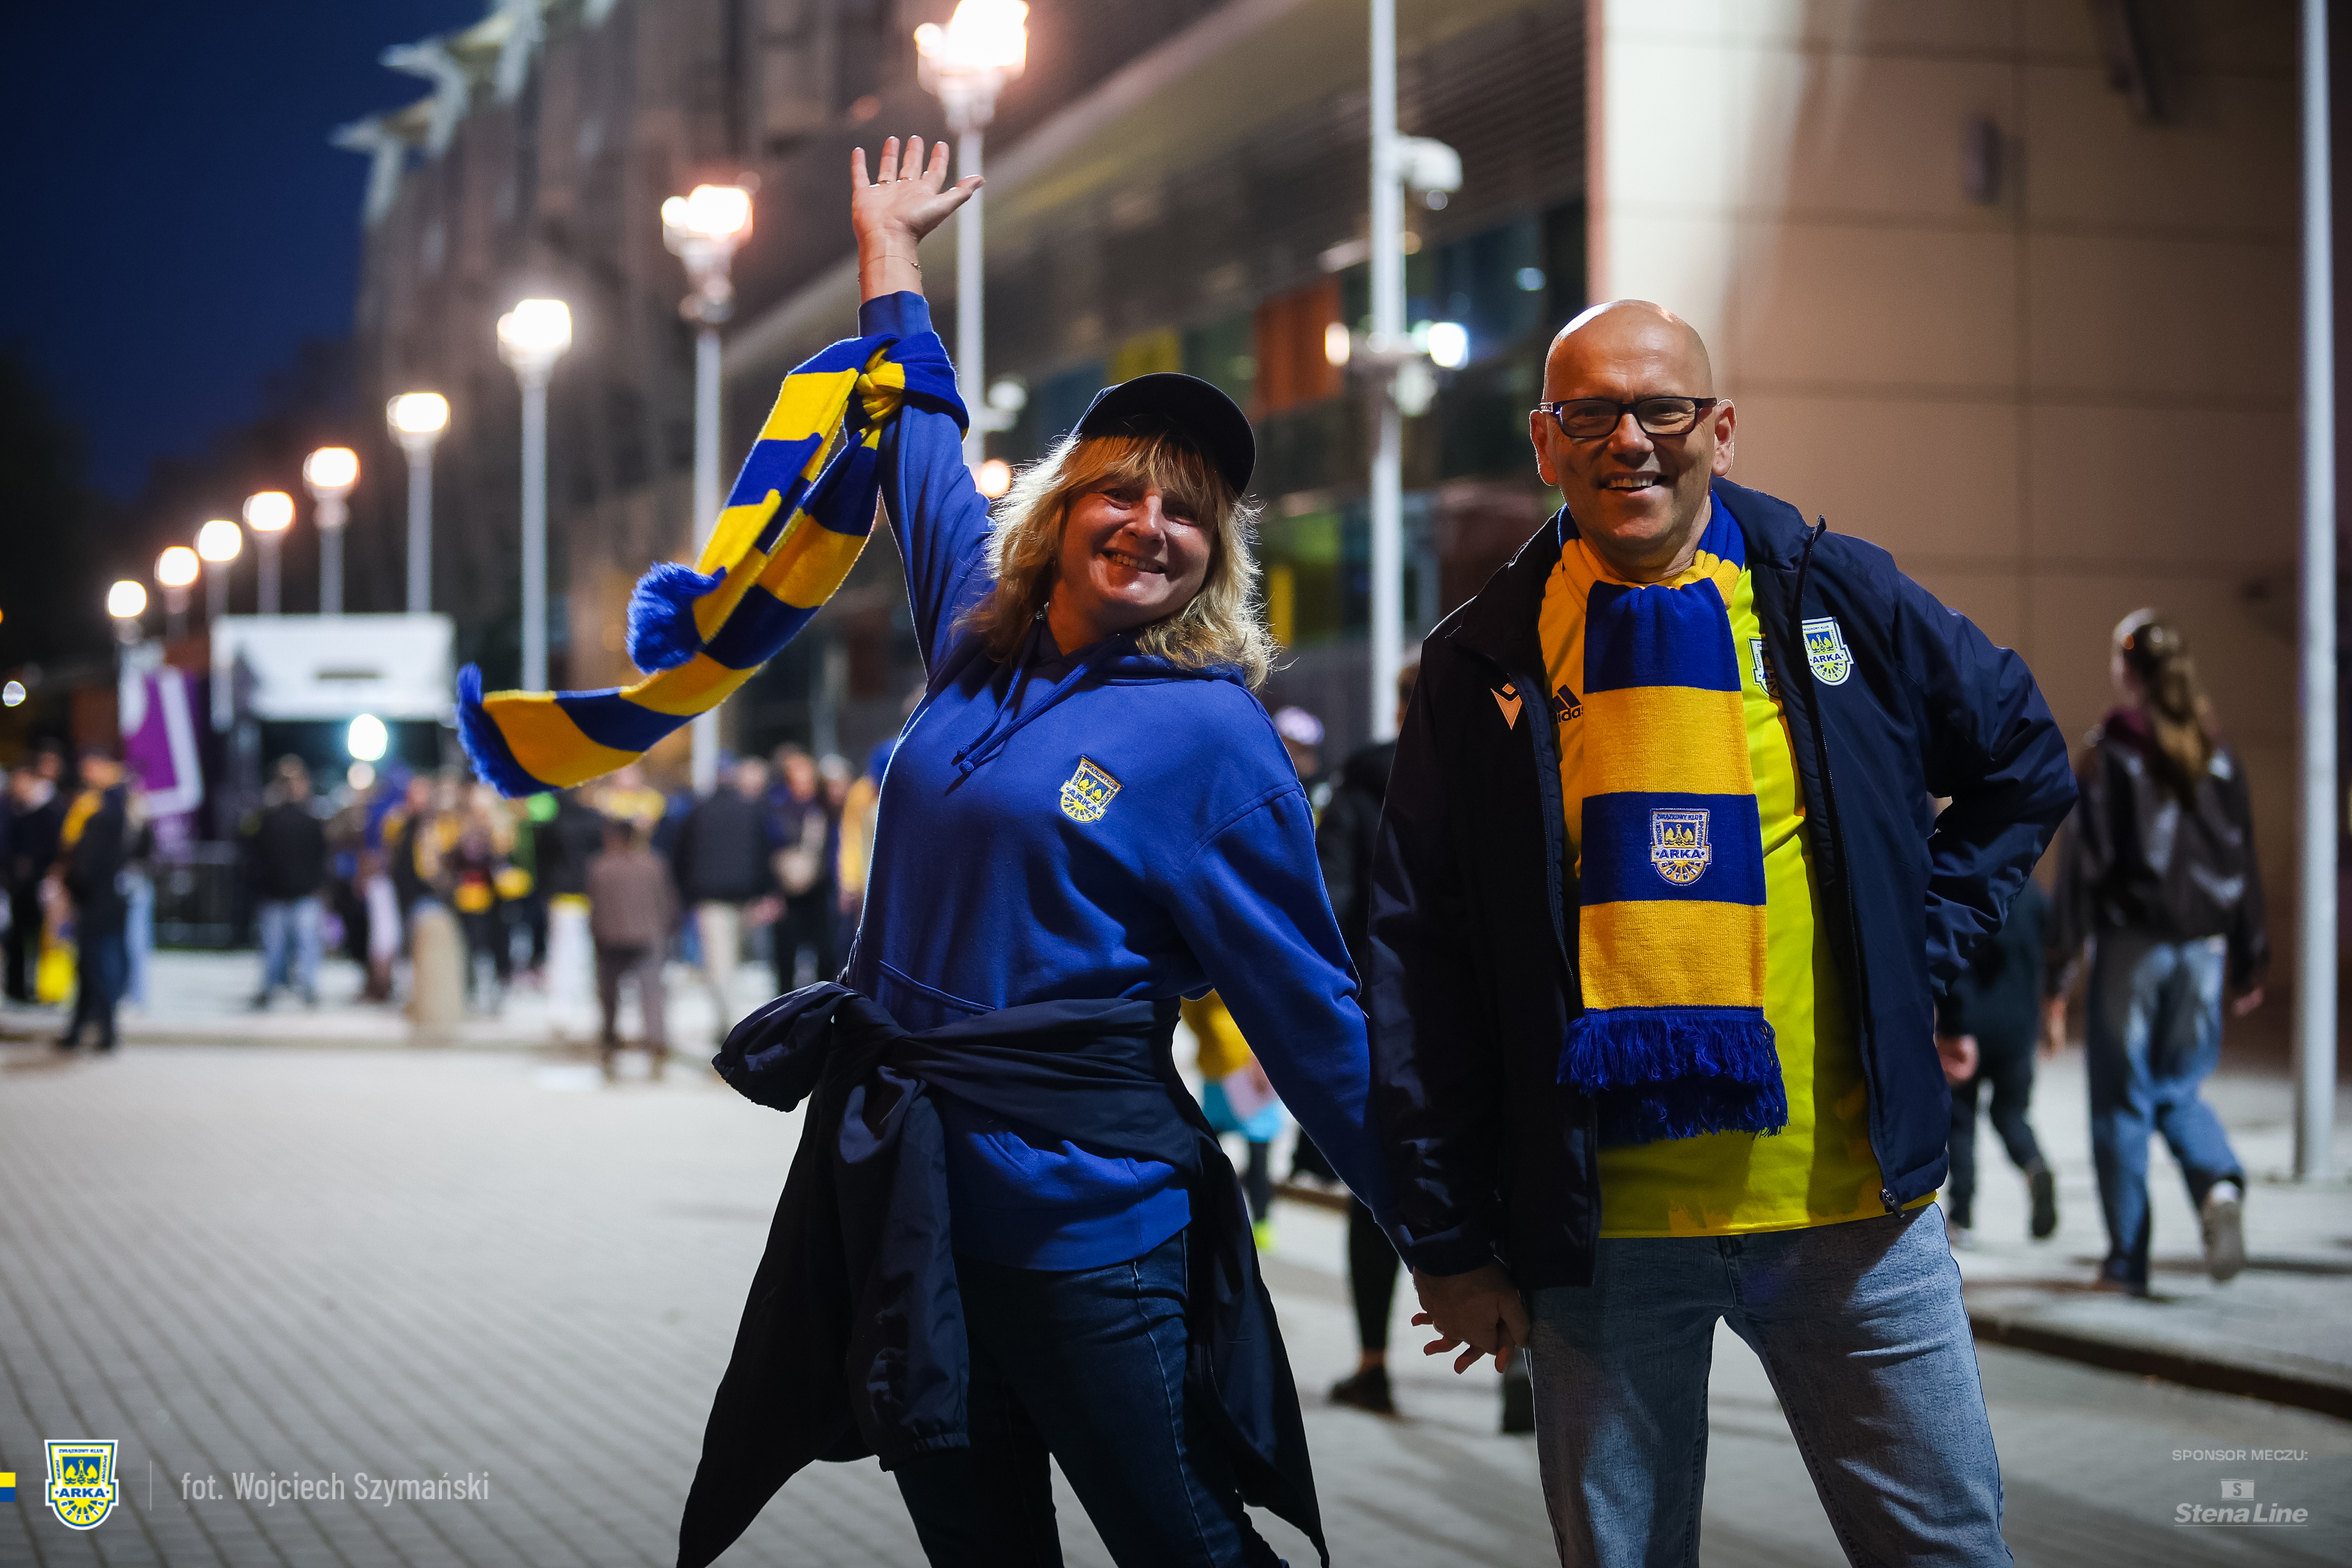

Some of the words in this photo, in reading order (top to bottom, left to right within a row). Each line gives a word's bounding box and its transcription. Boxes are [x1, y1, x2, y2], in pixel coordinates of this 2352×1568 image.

[1813, 653, 1842, 664] ARKA
[1069, 789, 1097, 814] ARKA
[1659, 850, 1701, 858] ARKA
